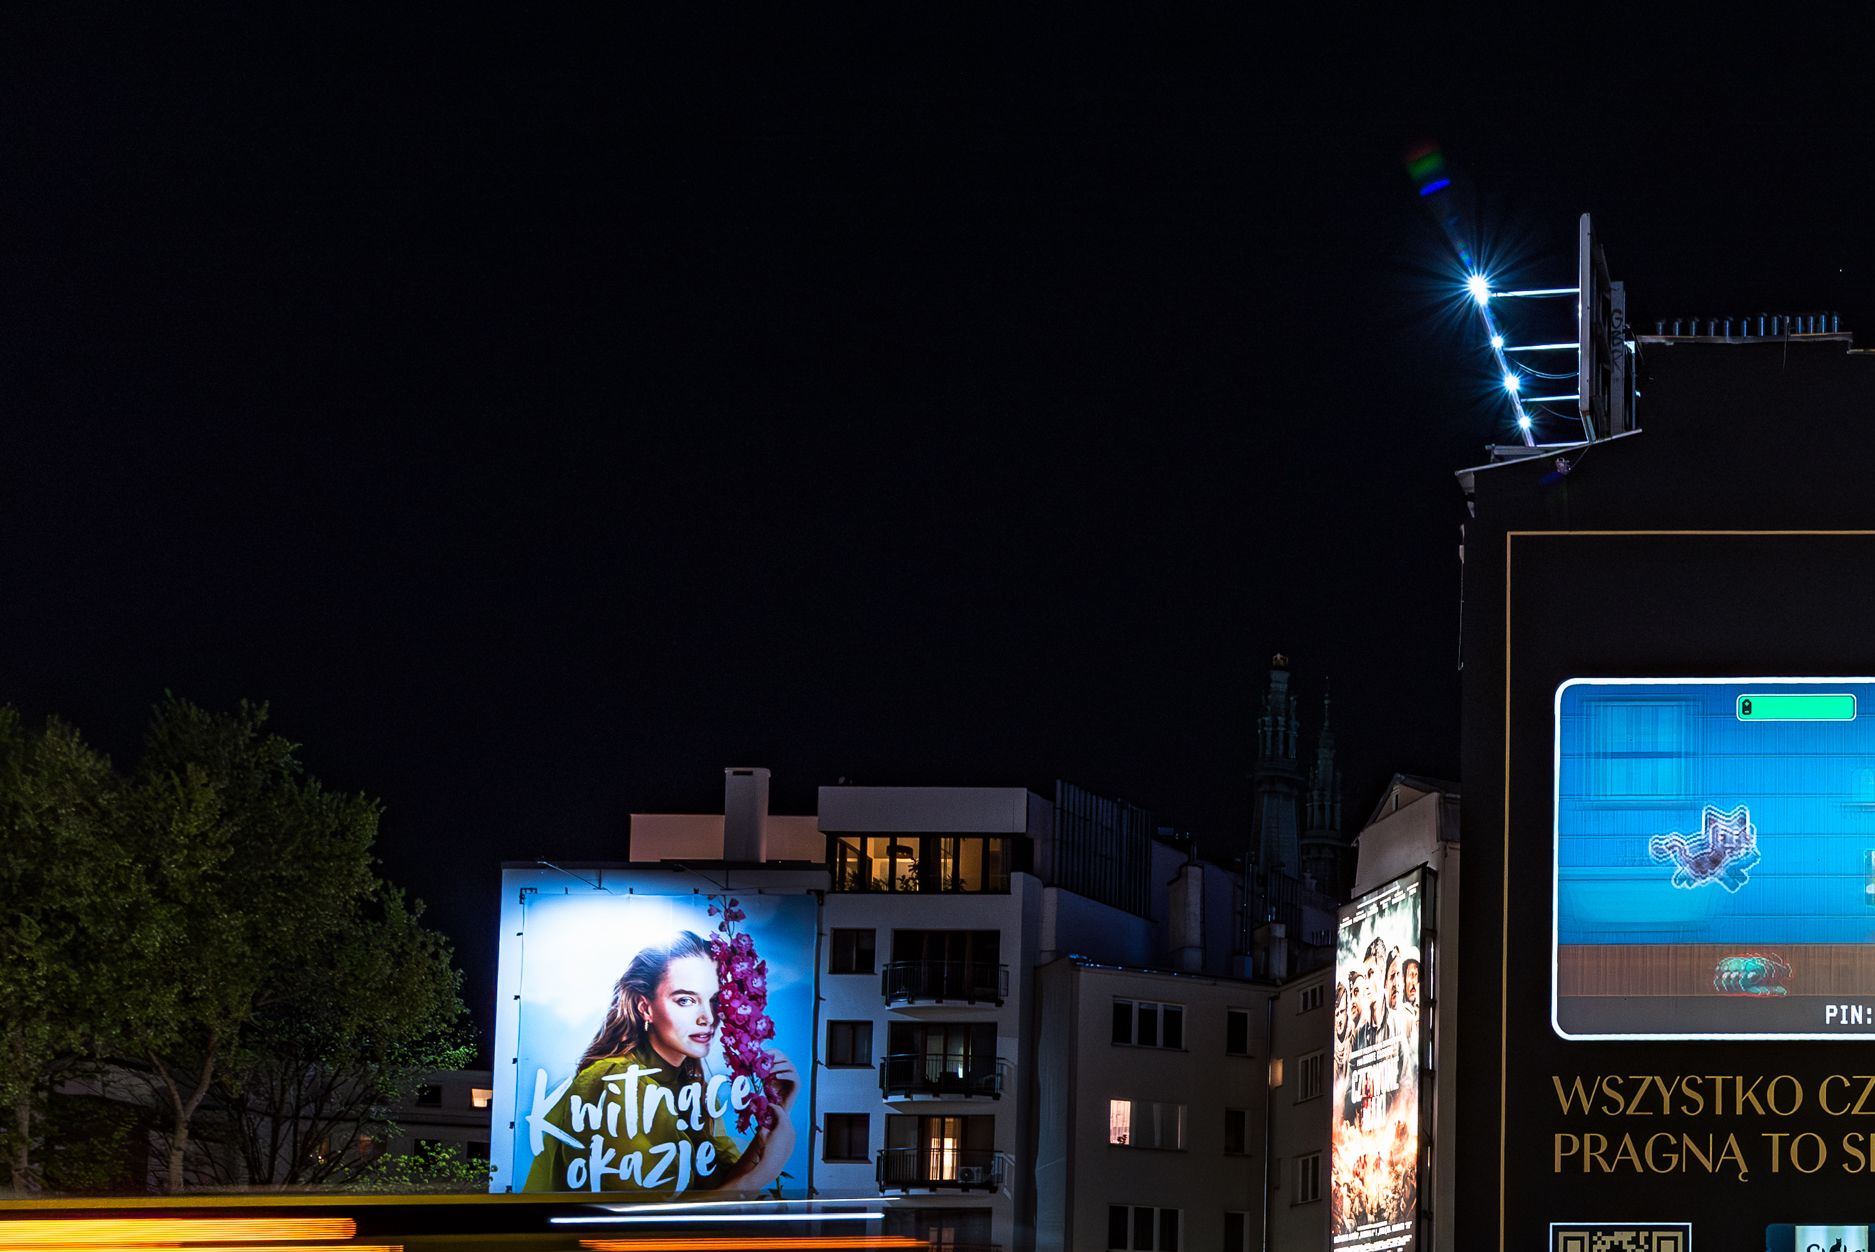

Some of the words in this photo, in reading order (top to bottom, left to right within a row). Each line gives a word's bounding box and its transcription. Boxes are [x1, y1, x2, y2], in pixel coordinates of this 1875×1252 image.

[1825, 1004, 1872, 1025] PIN:
[525, 1064, 752, 1157] Kwitnące
[1552, 1074, 1804, 1116] WSZYSTKO
[566, 1119, 718, 1199] okazje
[1554, 1132, 1749, 1182] PRAGNĄ
[1761, 1132, 1827, 1174] TO
